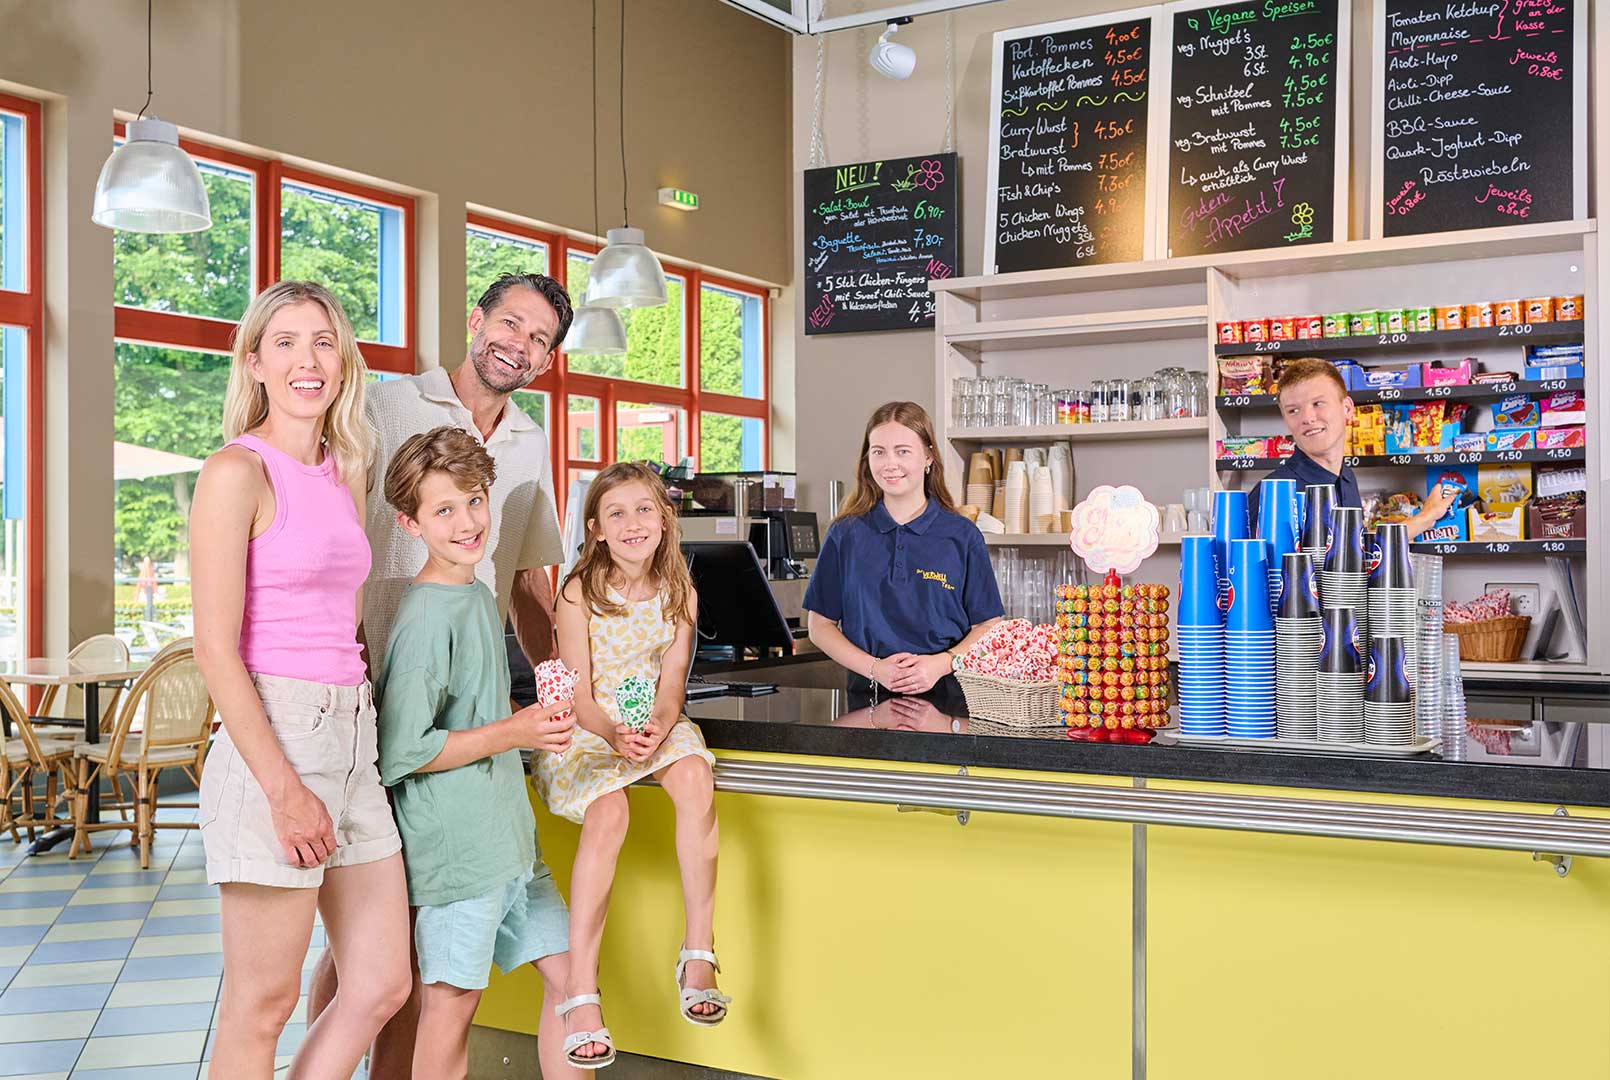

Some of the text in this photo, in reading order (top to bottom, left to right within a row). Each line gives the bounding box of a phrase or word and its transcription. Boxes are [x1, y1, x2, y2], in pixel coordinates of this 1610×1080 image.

[1207, 0, 1315, 34] Vegane Speisen
[1387, 4, 1500, 28] Tomaten Ketchup
[1546, 5, 1566, 15] der
[1515, 20, 1545, 31] Kasse
[1041, 36, 1093, 54] Pommes
[1391, 27, 1471, 51] Mayonnaise
[1177, 45, 1196, 57] veg.
[1509, 48, 1558, 65] jeweils
[1389, 52, 1458, 70] Aioli-Mayo
[1067, 74, 1103, 90] Pommes
[1387, 74, 1454, 91] Aioli-Dipp
[1176, 95, 1194, 108] veg.
[1195, 83, 1254, 104] Schnitzel
[1211, 103, 1230, 117] mit
[1233, 100, 1272, 113] Pommes
[1386, 116, 1479, 138] BBQ-Sauce
[1174, 138, 1192, 152] veg.
[1192, 122, 1256, 146] Bratwurst
[1211, 143, 1228, 154] mit
[1232, 137, 1266, 151] Pommes
[1001, 138, 1067, 160] Bratwurst
[1036, 158, 1056, 176] mit
[1057, 157, 1093, 173] Pommes
[1199, 166, 1230, 182] auch
[1232, 160, 1250, 174] als
[1419, 156, 1531, 186] Röstzwiebeln
[1474, 183, 1532, 204] jeweils
[1000, 213, 1009, 228] 5
[1011, 208, 1051, 225] Chicken
[1055, 204, 1084, 223] Wings
[1180, 192, 1230, 231] Guten
[818, 232, 862, 252] Baguette
[999, 230, 1040, 245] Chicken
[1043, 222, 1088, 244] Nuggets
[823, 276, 833, 292] 5
[835, 292, 850, 302] mit
[1344, 457, 1360, 467] 50
